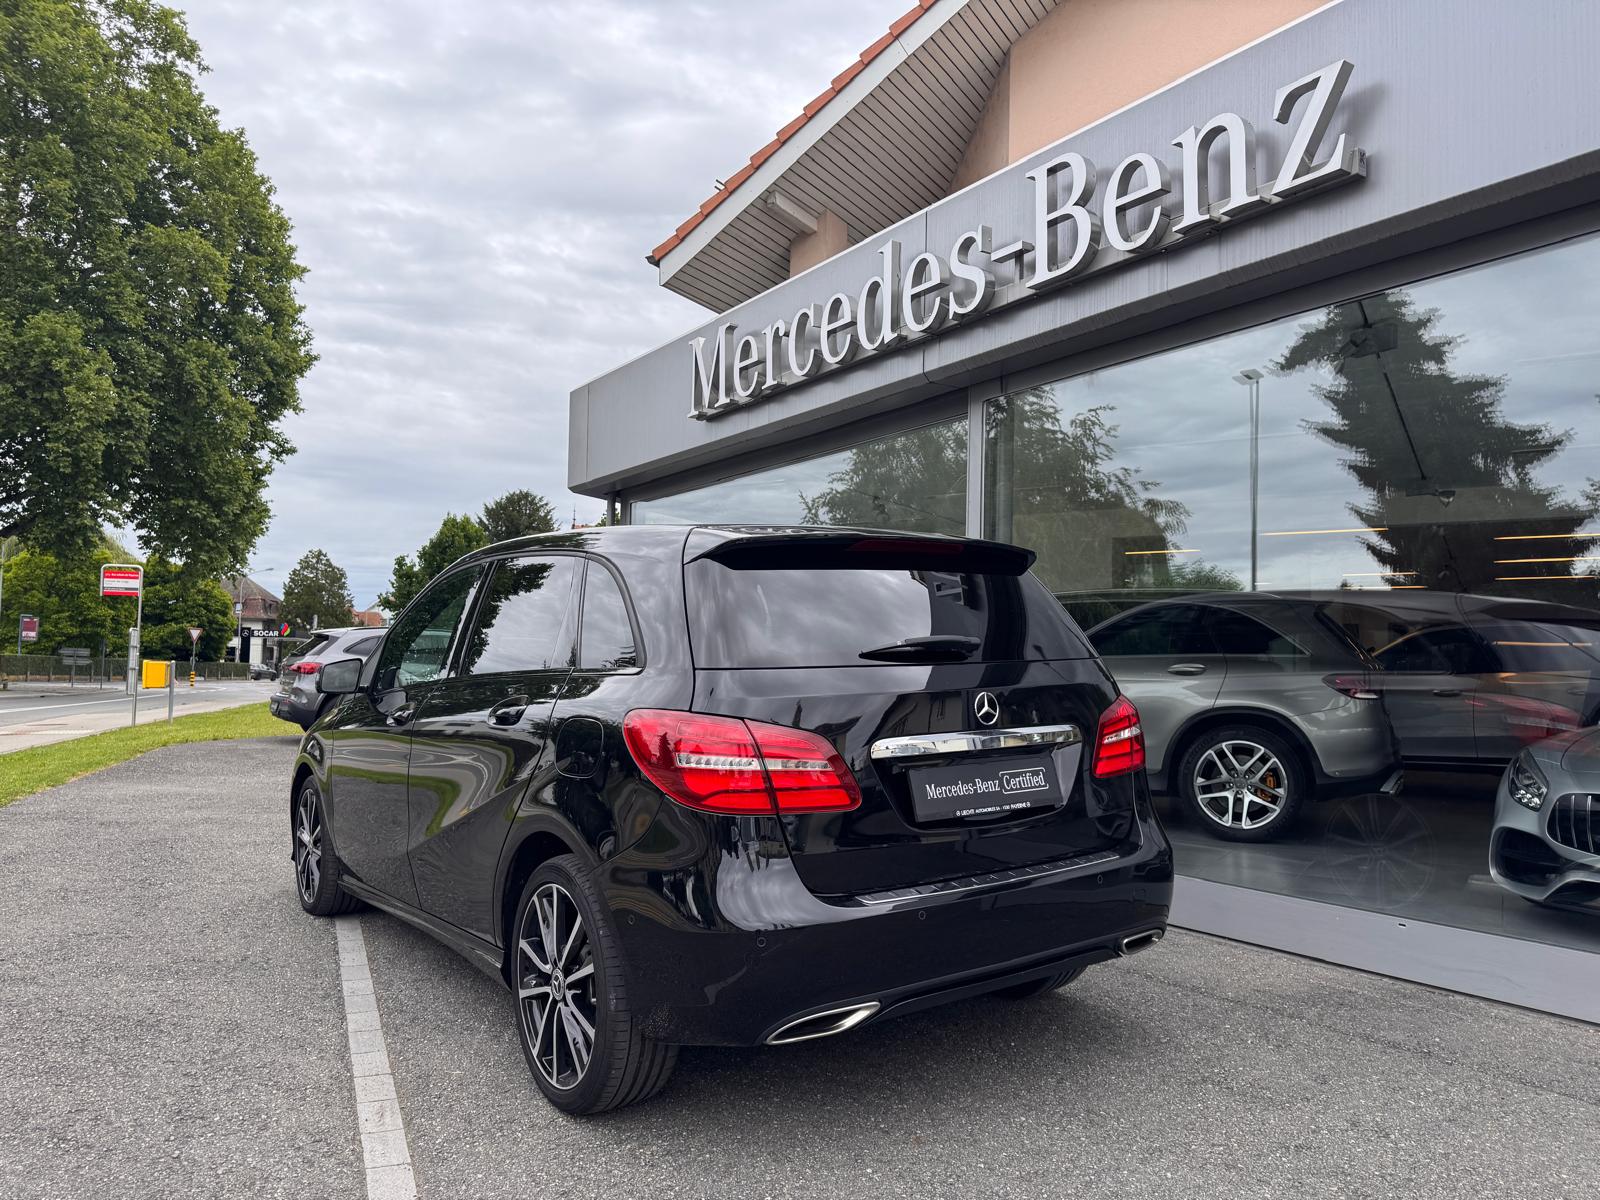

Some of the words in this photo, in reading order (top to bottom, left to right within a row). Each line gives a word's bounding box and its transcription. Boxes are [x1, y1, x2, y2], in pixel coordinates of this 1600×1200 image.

[687, 59, 1355, 420] Mercedes-Benz
[925, 778, 1000, 800] Mercedes-Benz
[1003, 772, 1045, 790] Certified
